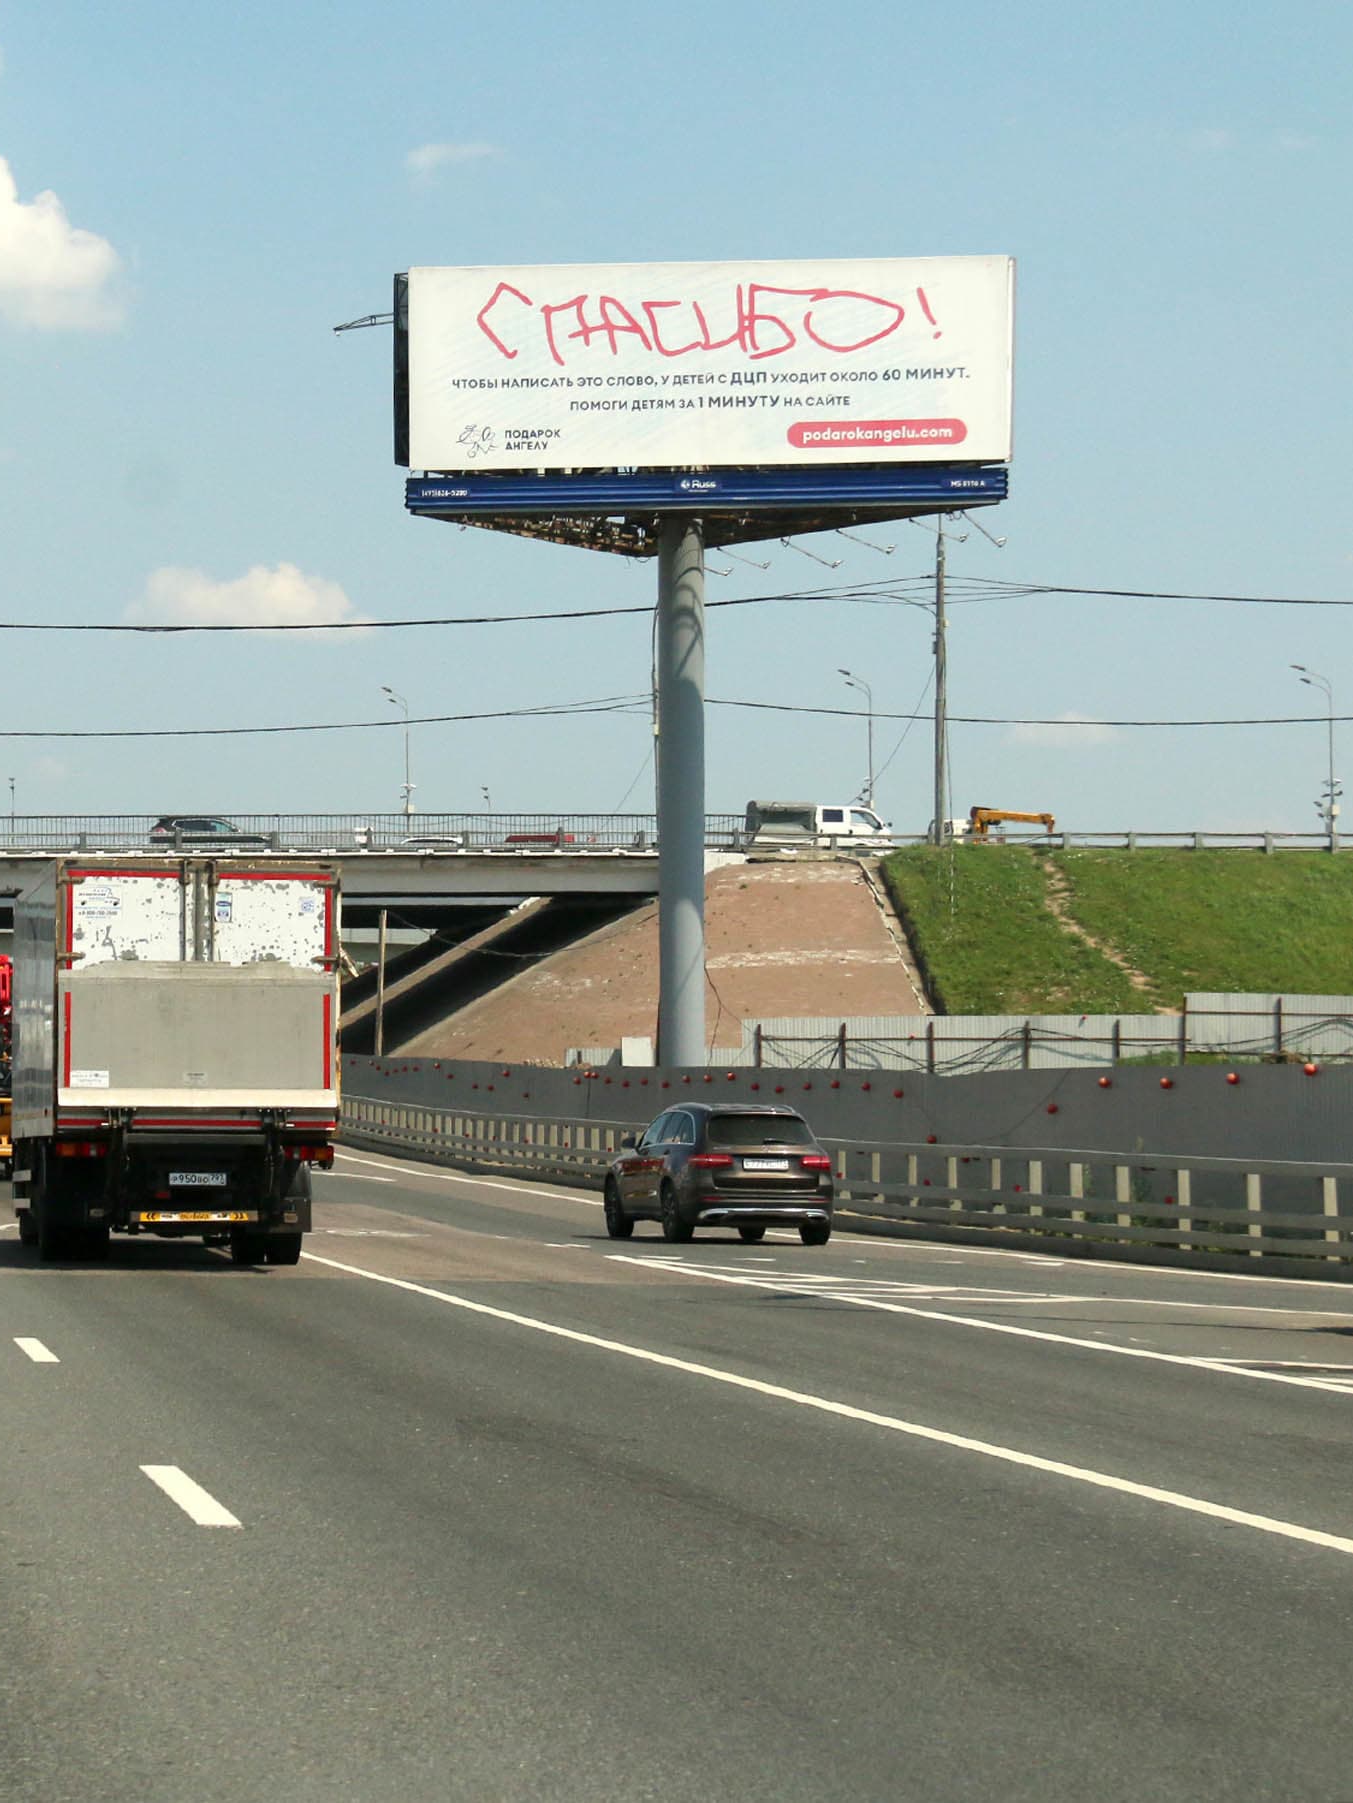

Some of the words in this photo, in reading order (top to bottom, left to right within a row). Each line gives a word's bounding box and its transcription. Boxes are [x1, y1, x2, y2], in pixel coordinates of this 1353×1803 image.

[476, 281, 942, 367] СПАСИБО!
[452, 378, 498, 389] ЧТОБЫ
[501, 376, 574, 389] НАПИСАТЬ
[576, 376, 604, 388] ЭТО
[606, 375, 658, 388] СЛОВО,
[660, 375, 670, 385] У
[672, 372, 715, 387] ДЕТЕЙ
[717, 373, 728, 384] С
[729, 371, 767, 387] ДЦП
[770, 372, 827, 385] УХОДИТ
[829, 371, 879, 383] ОКОЛО
[882, 368, 901, 382] 60
[905, 367, 970, 380] МИНУТ.
[569, 399, 628, 411] ПОМОГИ
[631, 399, 676, 412] ДЕТЯМ
[678, 398, 695, 409] ЗА
[698, 396, 704, 409] 1
[708, 395, 780, 409] МИНУТУ
[783, 397, 803, 407] НА
[805, 394, 851, 407] САЙТЕ
[504, 428, 561, 440] ПОДАРОК
[802, 425, 954, 445] podarokangelu.com
[504, 440, 549, 451] АНГЕЛУ
[691, 479, 717, 489] Russ
